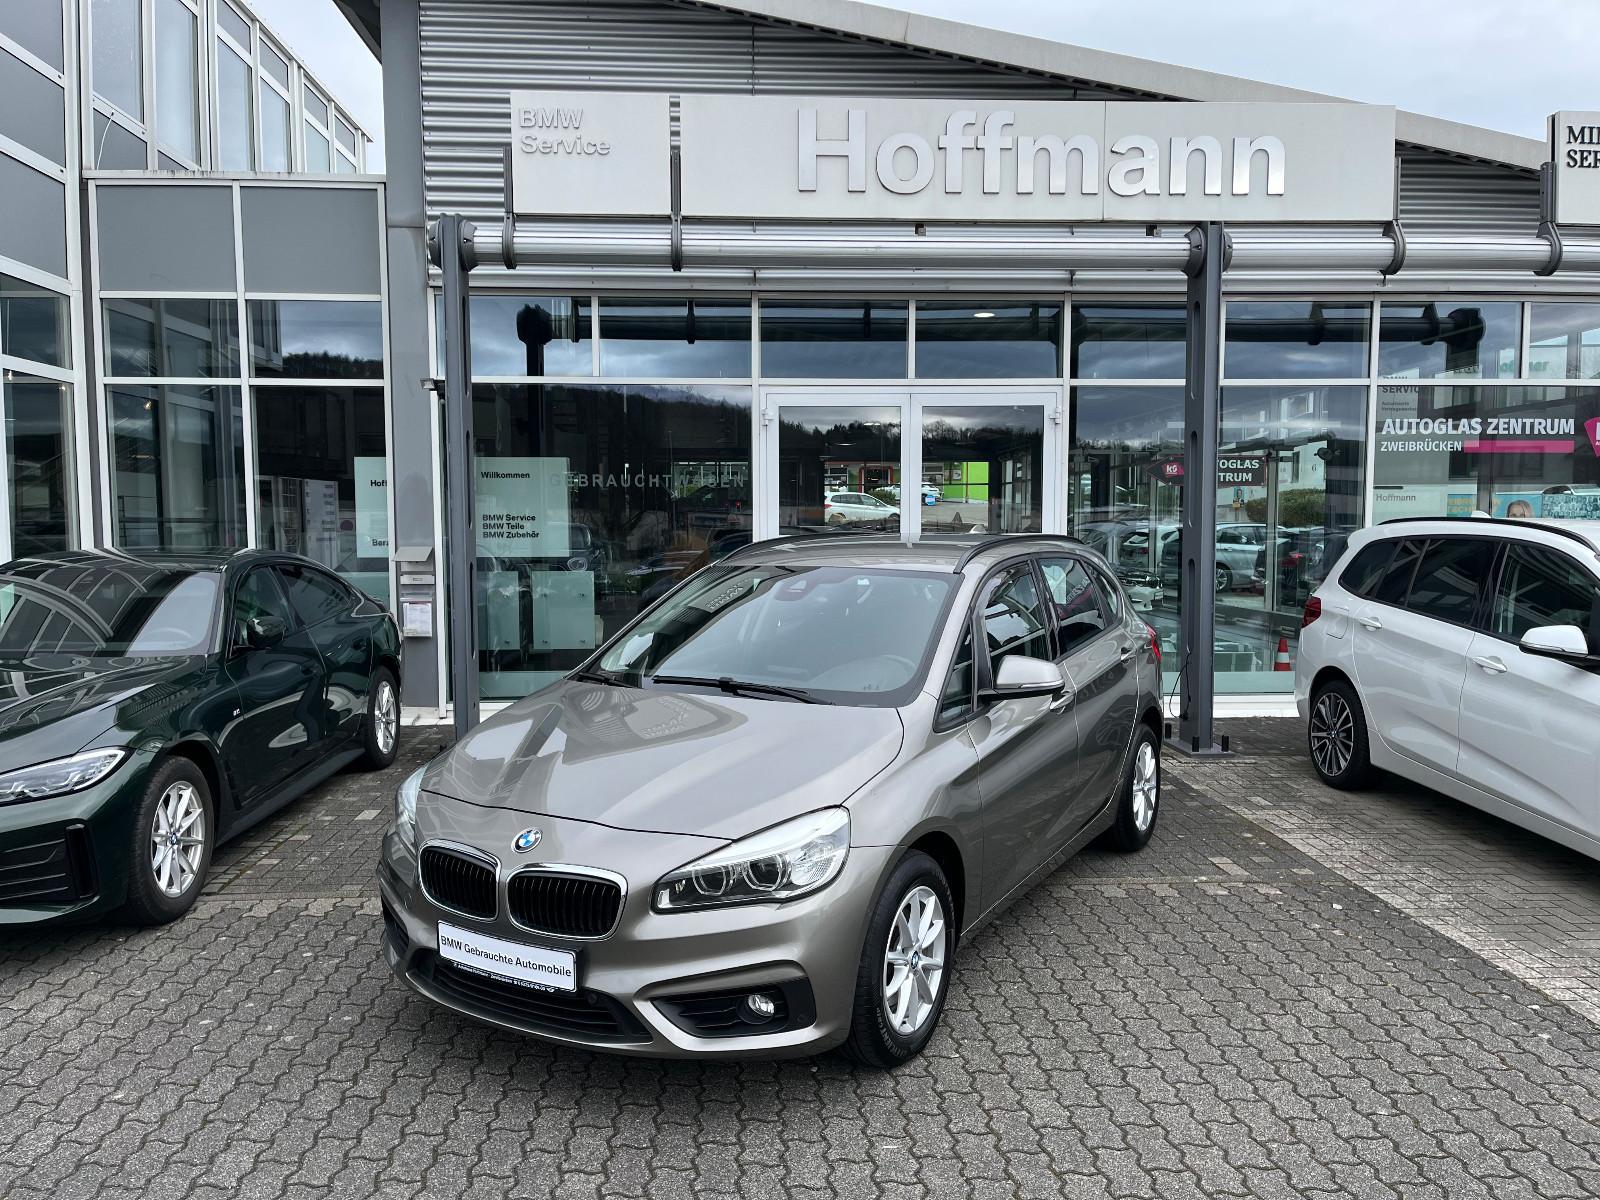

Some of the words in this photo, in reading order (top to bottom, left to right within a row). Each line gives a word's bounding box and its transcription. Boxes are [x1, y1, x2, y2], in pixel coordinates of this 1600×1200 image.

[519, 107, 584, 129] BMW
[1566, 126, 1600, 145] MI
[521, 134, 611, 156] Service
[797, 109, 1286, 196] Hoffmann
[1381, 417, 1483, 435] AUTOGLAS
[1486, 418, 1575, 435] ZENTRUM
[1380, 438, 1462, 452] ZWEIBRÜCKEN
[1217, 459, 1260, 468] OGLAS
[480, 471, 531, 479] Willkommen
[505, 513, 537, 521] Service
[482, 522, 505, 530] BMW
[482, 531, 505, 539] BMW
[505, 530, 540, 539] Zubehör
[440, 935, 463, 951] BMW
[464, 943, 514, 965] Gebrauchte
[515, 956, 572, 977] Automobile
